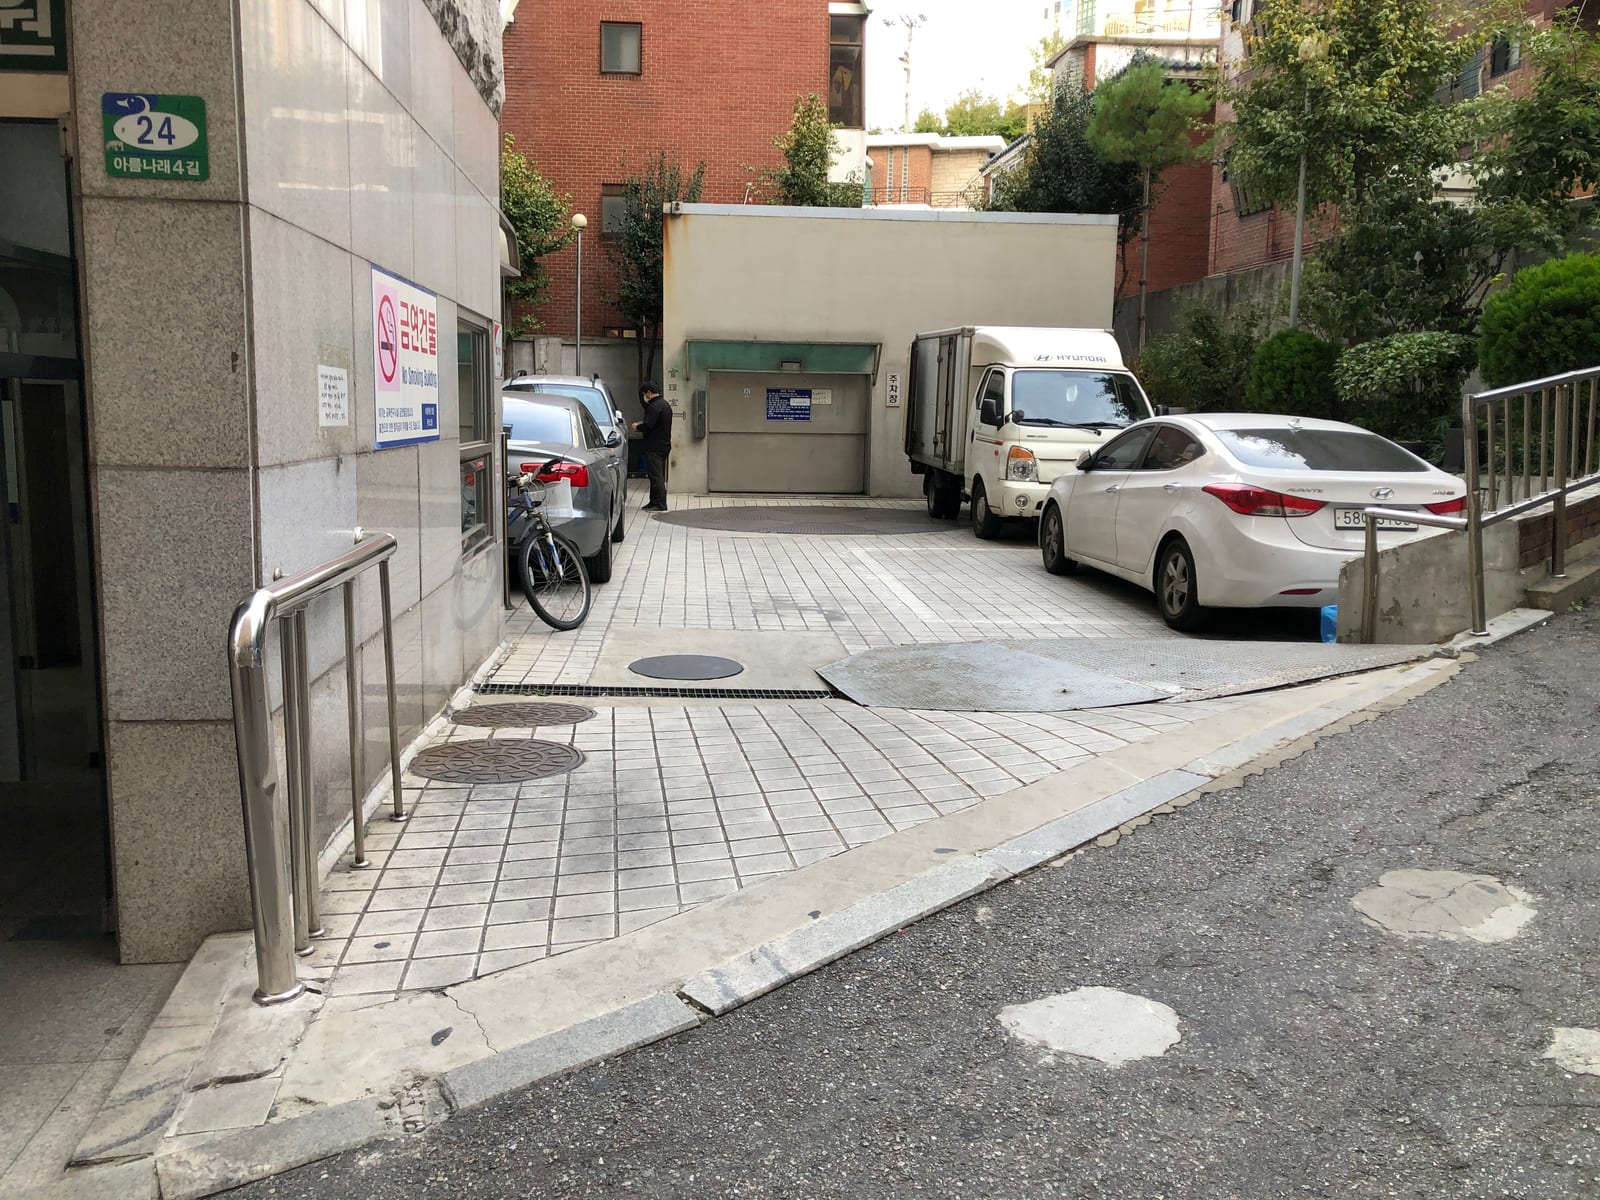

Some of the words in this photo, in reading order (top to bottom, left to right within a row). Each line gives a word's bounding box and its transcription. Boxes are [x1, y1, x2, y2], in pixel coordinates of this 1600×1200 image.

[136, 115, 176, 146] 24
[113, 156, 201, 176] 아름나래4길
[400, 300, 437, 356] 금연건물
[1056, 354, 1107, 363] HYUNDAI
[402, 366, 408, 384] No
[408, 367, 424, 387] Smoking
[424, 369, 437, 388] Building
[889, 374, 898, 404] 주차장
